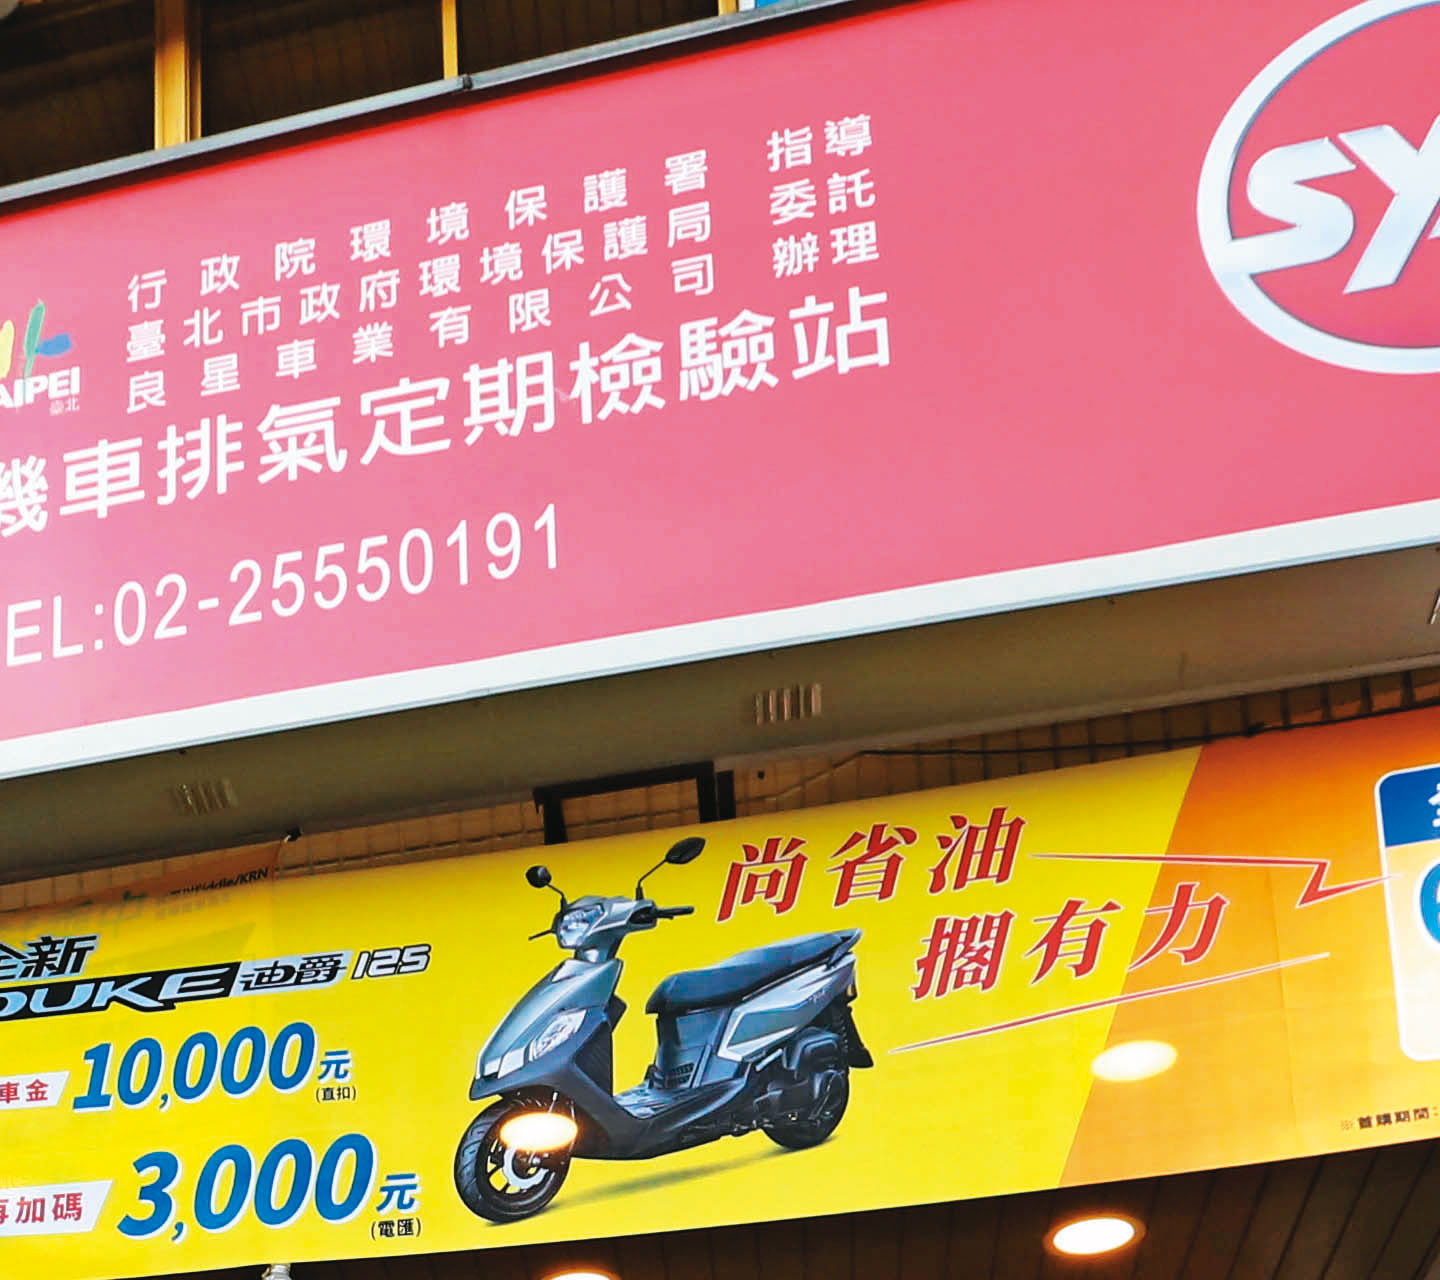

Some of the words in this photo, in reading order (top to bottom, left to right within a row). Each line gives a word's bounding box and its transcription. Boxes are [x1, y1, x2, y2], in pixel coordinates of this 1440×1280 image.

[126, 201, 713, 365] 臺北市政府環境保護局
[769, 168, 877, 226] 委託
[127, 148, 710, 314] 行政院環境保護署
[766, 113, 874, 173] 指導
[126, 253, 715, 414] 良星車業有限公司
[772, 220, 880, 279] 辦理
[717, 807, 1028, 923] 尚省油
[240, 953, 349, 990] 迪爵
[351, 944, 432, 980] 125
[910, 881, 1230, 1001] 擱有力
[72, 1021, 317, 1111] 10,000
[318, 1049, 352, 1082] 元
[314, 1084, 358, 1104] (直扣)
[118, 1132, 374, 1245] 3,000
[378, 1173, 419, 1210] 元
[370, 1216, 423, 1240] (電匯)
